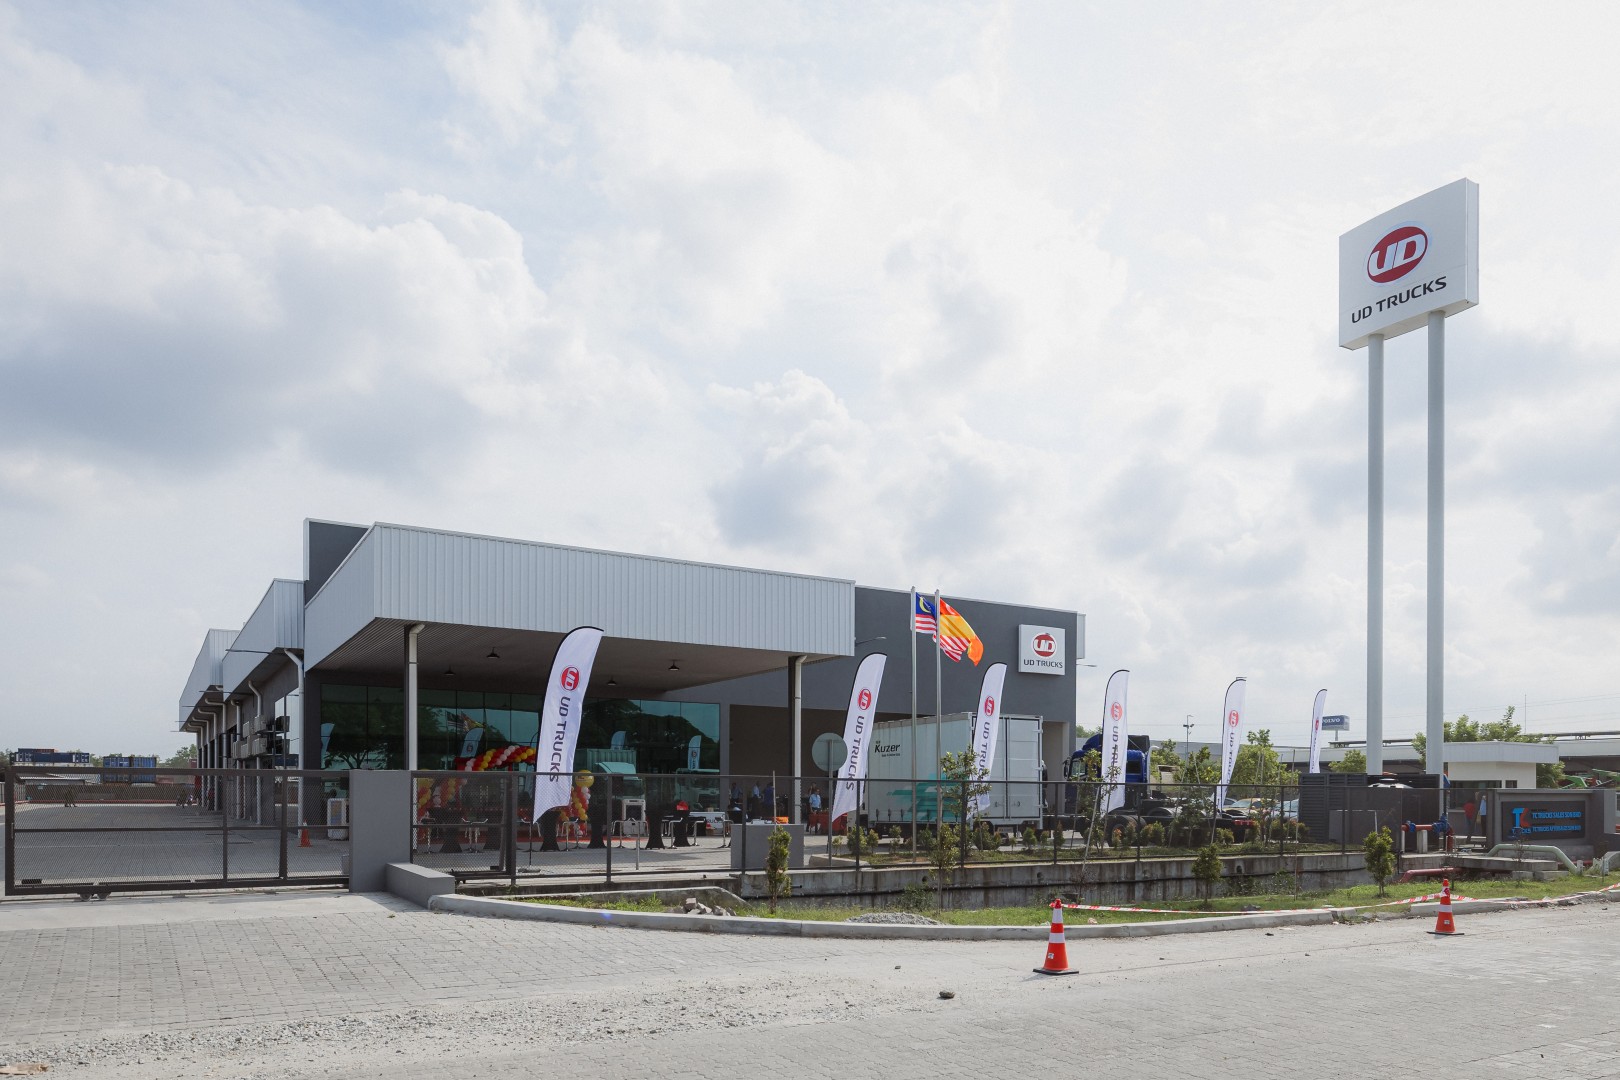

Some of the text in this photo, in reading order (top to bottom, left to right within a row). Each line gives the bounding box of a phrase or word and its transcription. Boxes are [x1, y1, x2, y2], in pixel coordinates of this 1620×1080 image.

[1367, 232, 1427, 278] UD
[1351, 275, 1447, 324] UD TRUCKS
[1033, 638, 1056, 653] UD
[1036, 660, 1064, 669] TRUCKS
[562, 666, 579, 691] UD
[855, 715, 865, 735] UD
[982, 721, 991, 740] UD
[1112, 726, 1119, 741] UD
[549, 696, 571, 783] UD TRUCKS
[874, 744, 901, 753] Kuzer
